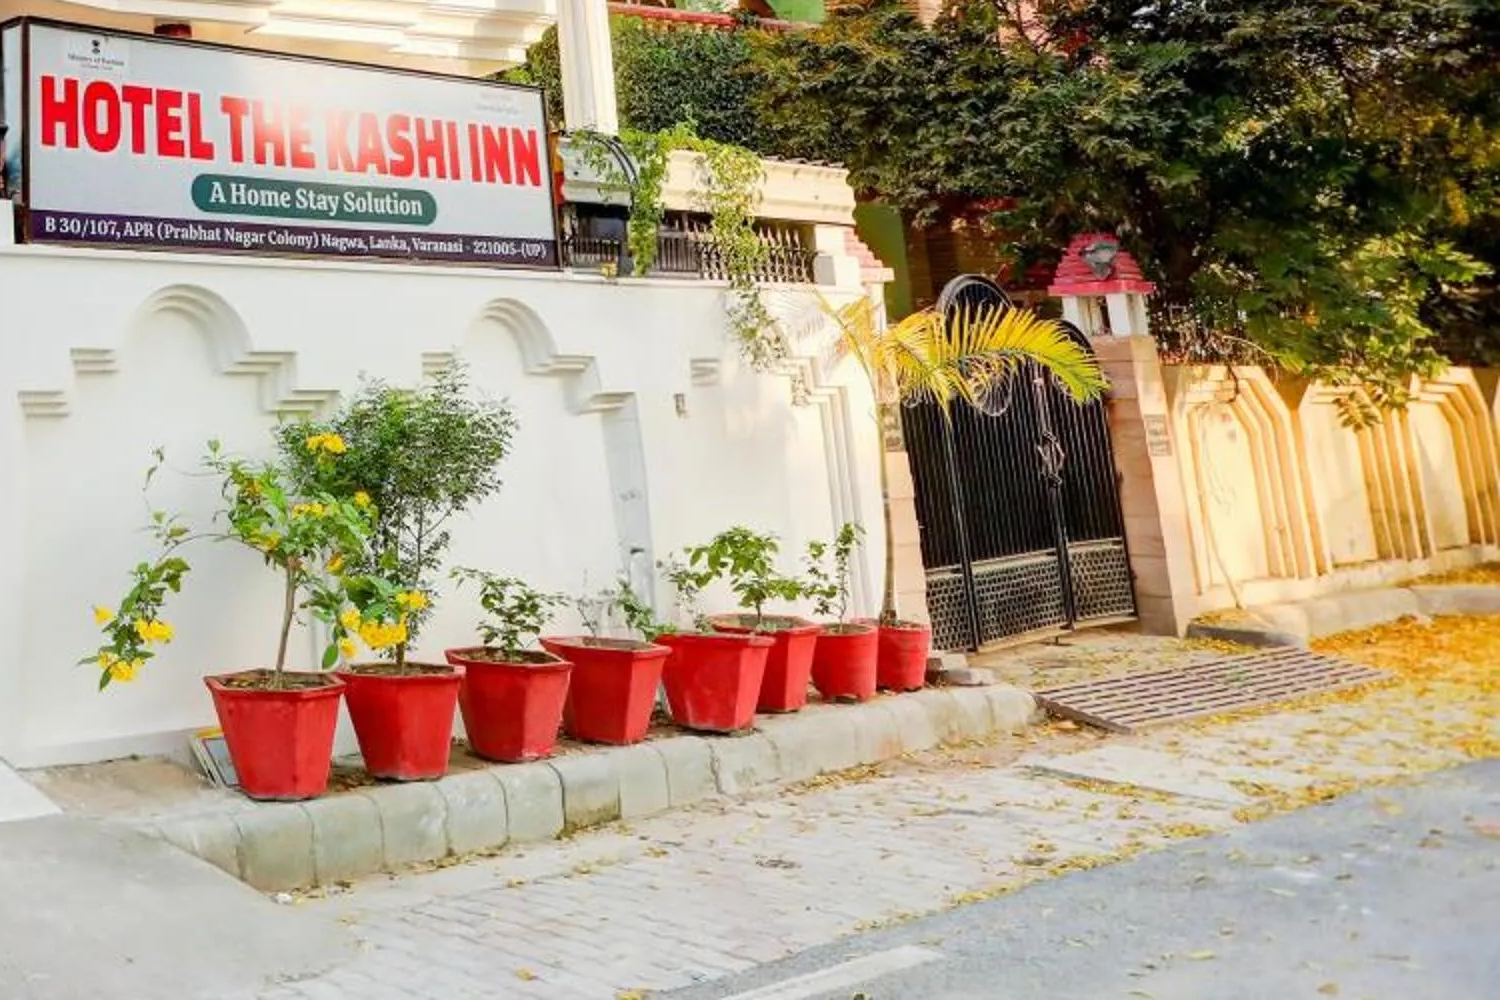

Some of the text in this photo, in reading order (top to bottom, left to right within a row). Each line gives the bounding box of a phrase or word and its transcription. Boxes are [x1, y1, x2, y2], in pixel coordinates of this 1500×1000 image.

[41, 75, 541, 187] HOTEL THE KASHI INN
[210, 181, 423, 216] A Home Stay Solution
[45, 217, 56, 232] B
[59, 218, 121, 239] 30/107,
[123, 222, 154, 238] APR
[157, 223, 220, 241] (Prabhat
[224, 227, 266, 247] Nagar
[267, 231, 319, 248] Colony)
[321, 233, 368, 252] Nagwa,
[369, 235, 411, 253] Lanka,
[412, 237, 464, 253] Varanasi
